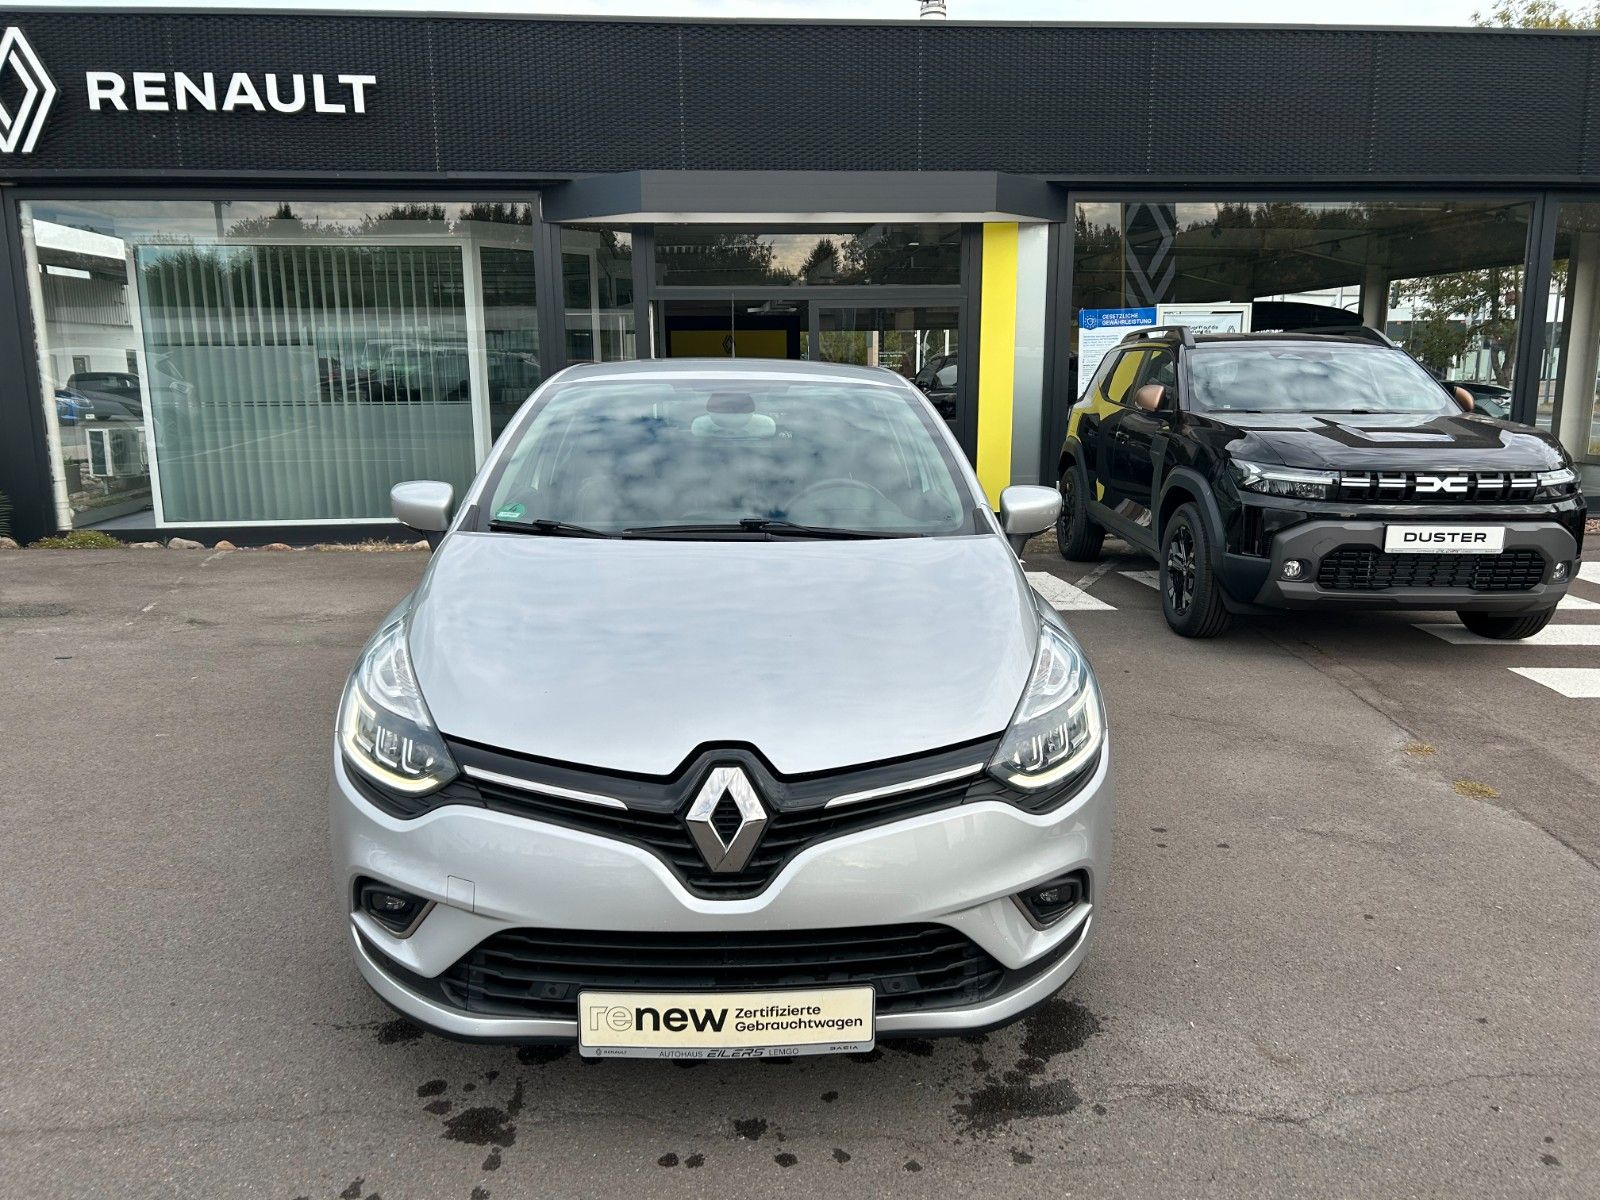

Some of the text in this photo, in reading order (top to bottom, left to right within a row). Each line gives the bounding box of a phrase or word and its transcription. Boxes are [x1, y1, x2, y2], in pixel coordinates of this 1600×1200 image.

[85, 71, 377, 114] RENAULT
[1101, 312, 1139, 320] GESETZLICHE
[1101, 318, 1152, 326] GEWÄHRLEISTUNG
[1403, 532, 1487, 543] DUSTER
[735, 1005, 821, 1019] Zertifizierte
[589, 1005, 729, 1032] renew
[735, 1018, 863, 1032] Gebrauchtwagen
[659, 1047, 800, 1058] AUTOHAUS EILERS LEMGO
